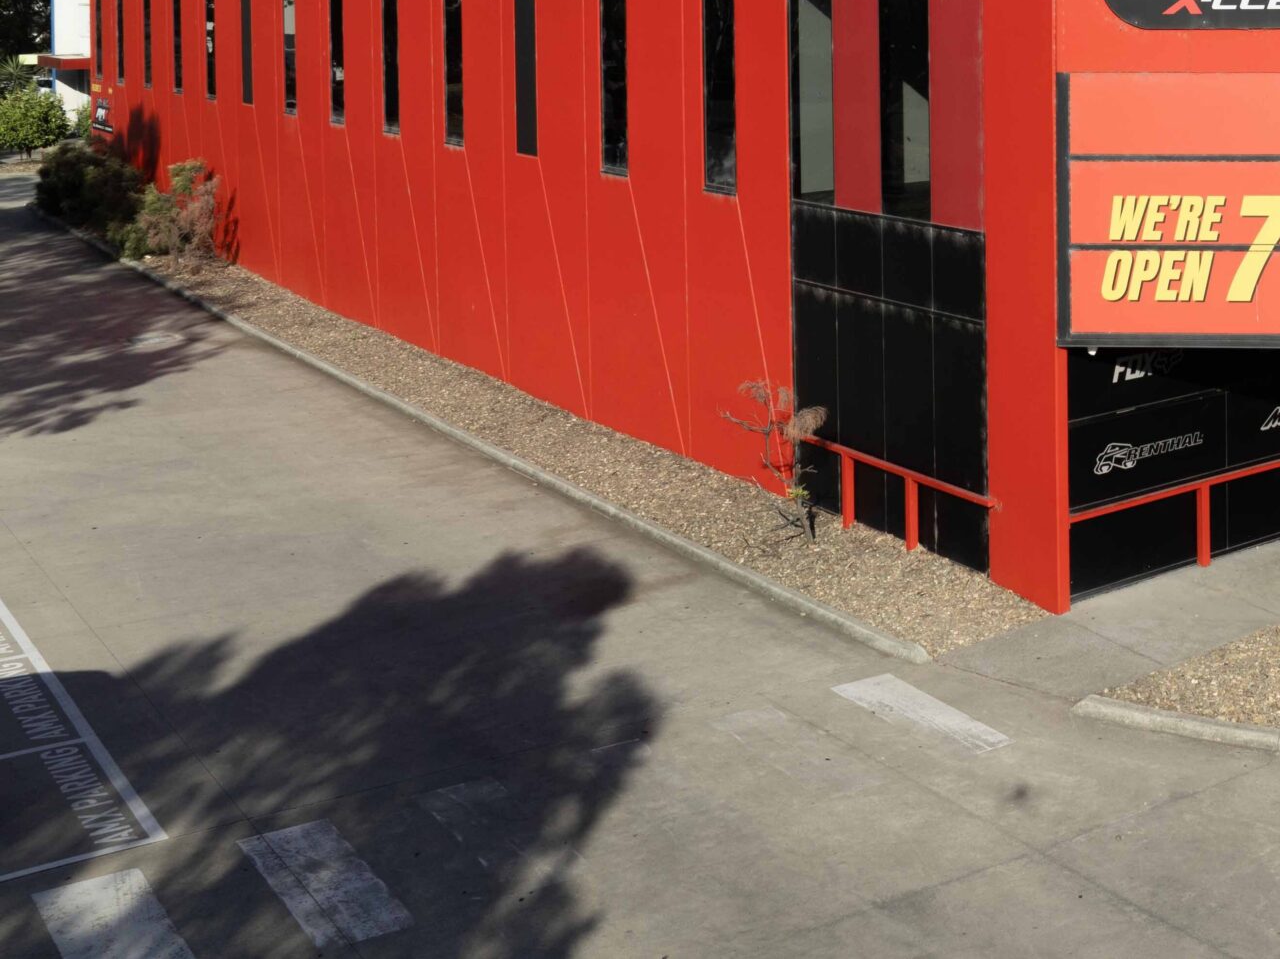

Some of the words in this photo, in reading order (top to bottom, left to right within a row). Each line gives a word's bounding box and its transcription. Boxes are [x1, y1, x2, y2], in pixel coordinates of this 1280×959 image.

[1109, 195, 1226, 241] WE'RE
[1100, 250, 1214, 302] OPEN
[1126, 431, 1204, 462] RENTHAL
[17, 710, 70, 740] AMX
[40, 743, 114, 811] PARKING
[78, 807, 140, 844] AMX
